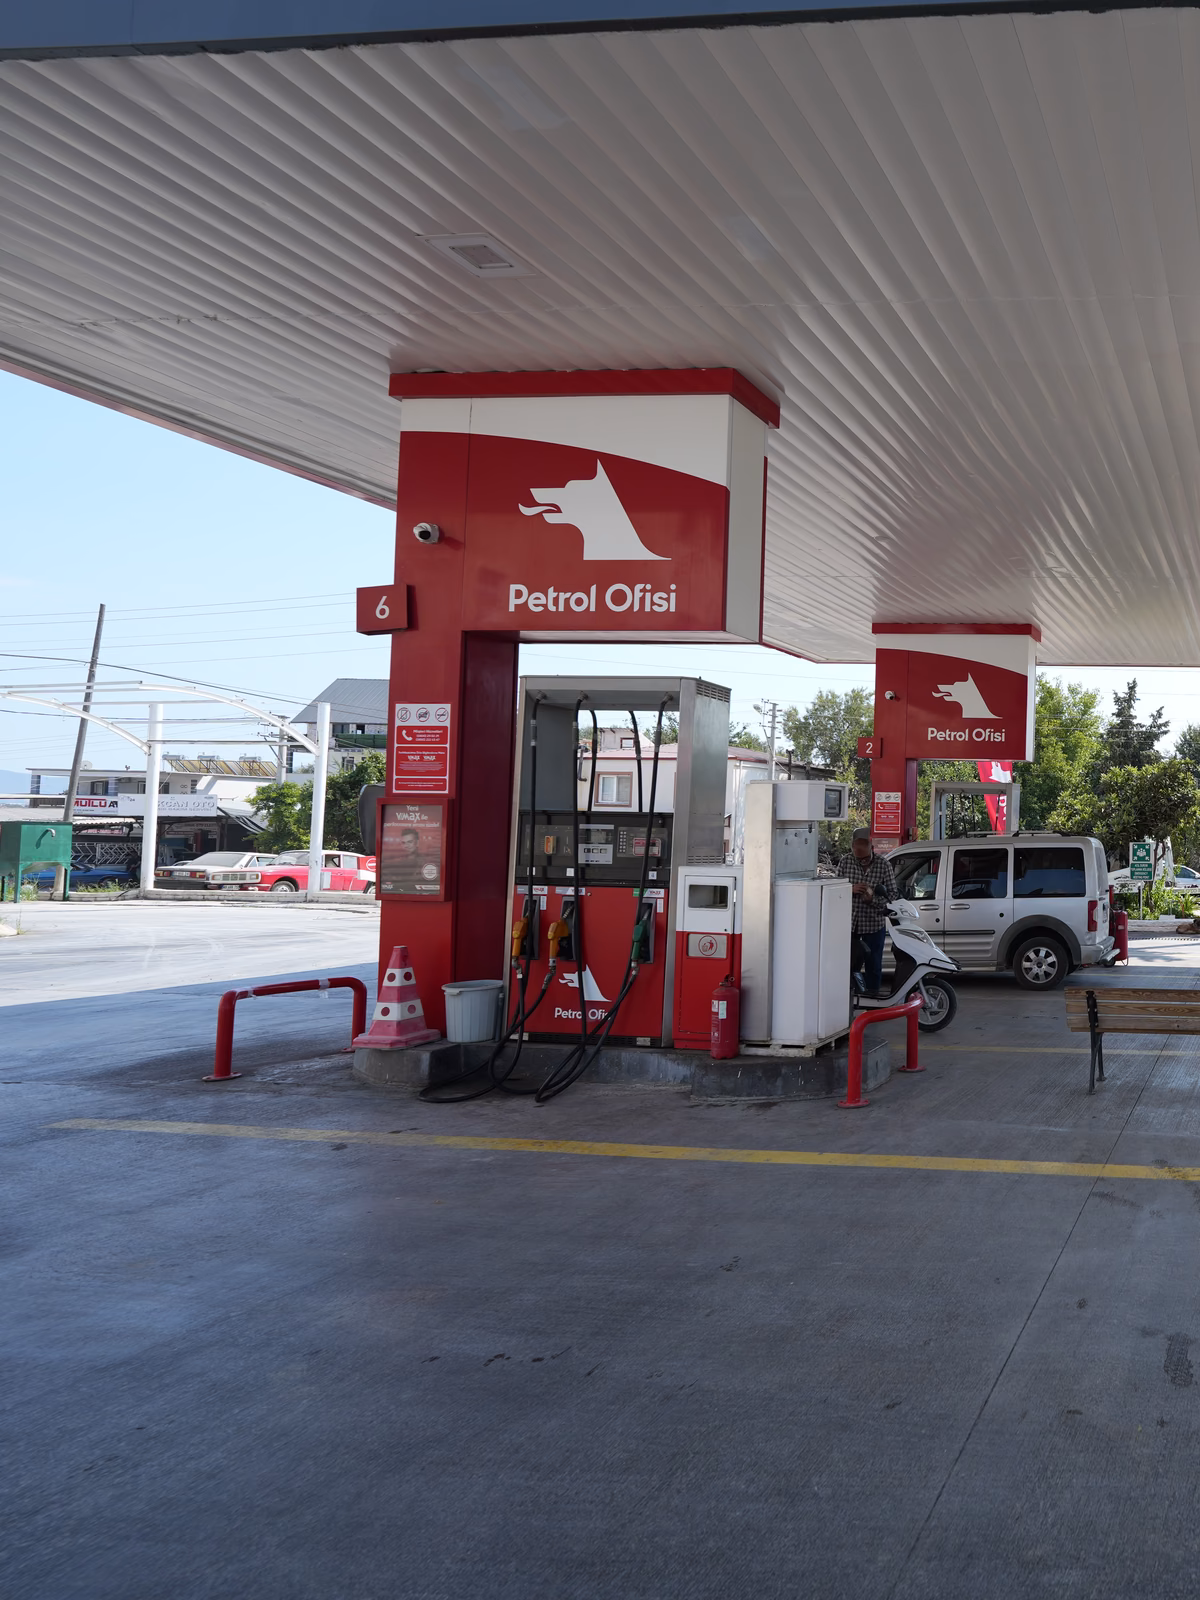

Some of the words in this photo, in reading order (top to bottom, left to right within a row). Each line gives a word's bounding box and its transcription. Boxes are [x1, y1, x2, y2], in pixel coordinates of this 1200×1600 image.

[508, 583, 597, 613] Petrol
[605, 583, 677, 613] Ofisi
[375, 595, 390, 619] 6
[927, 727, 969, 741] Petrol
[972, 728, 1006, 742] Ofisi
[865, 741, 873, 754] 2
[554, 1007, 583, 1019] Petro
